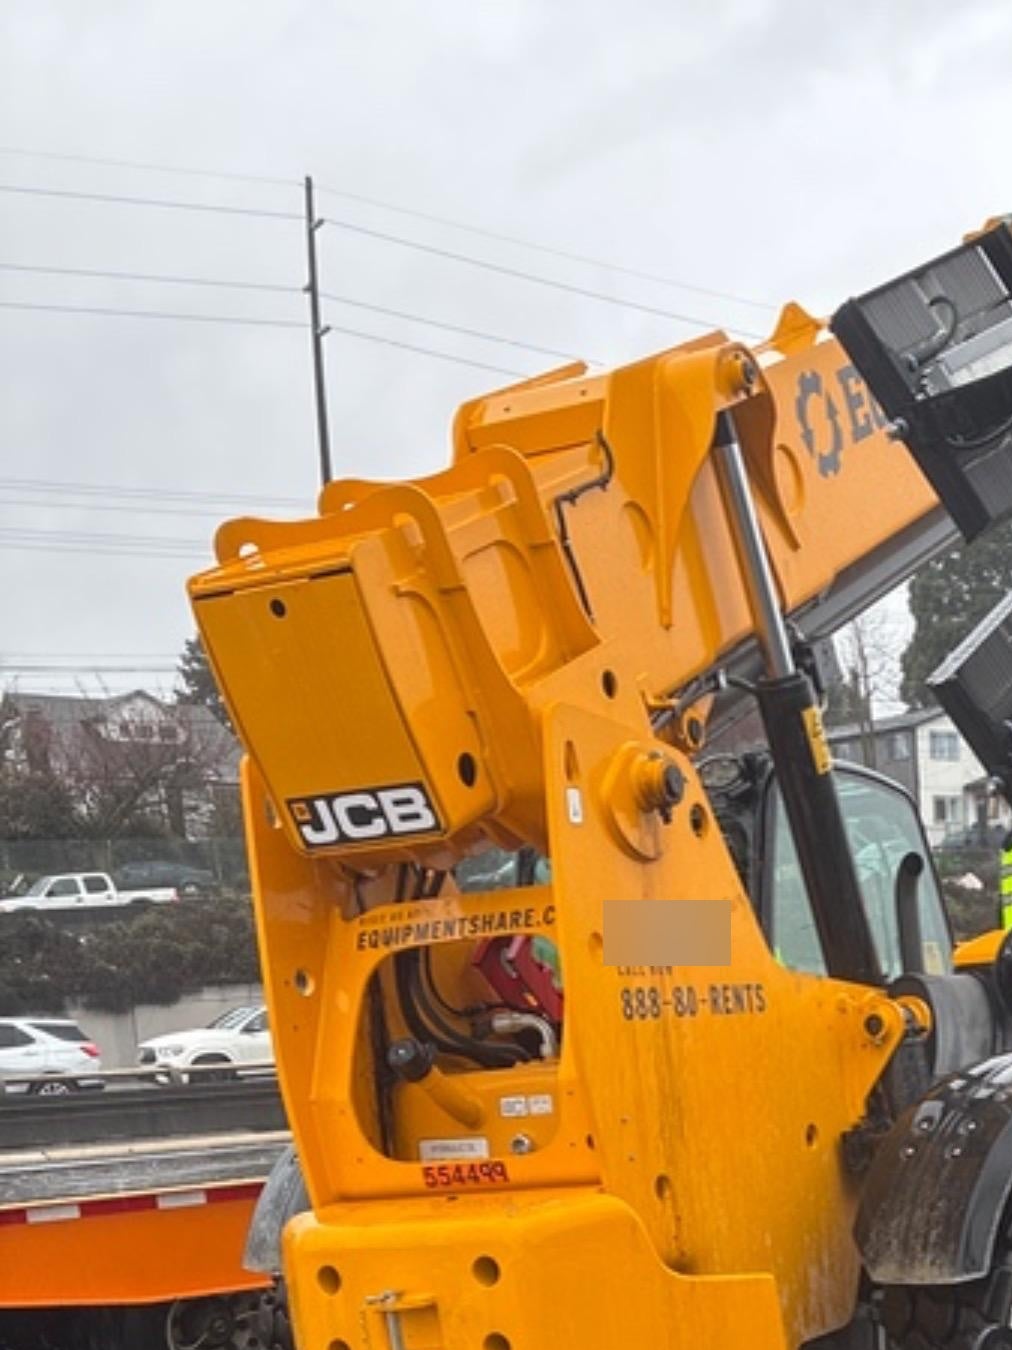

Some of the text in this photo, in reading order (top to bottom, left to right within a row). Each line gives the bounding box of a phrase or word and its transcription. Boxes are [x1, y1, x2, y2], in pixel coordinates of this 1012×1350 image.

[301, 787, 436, 845] JCB
[619, 982, 767, 1021] 888-80-RENTS
[422, 1161, 511, 1188] 554499
